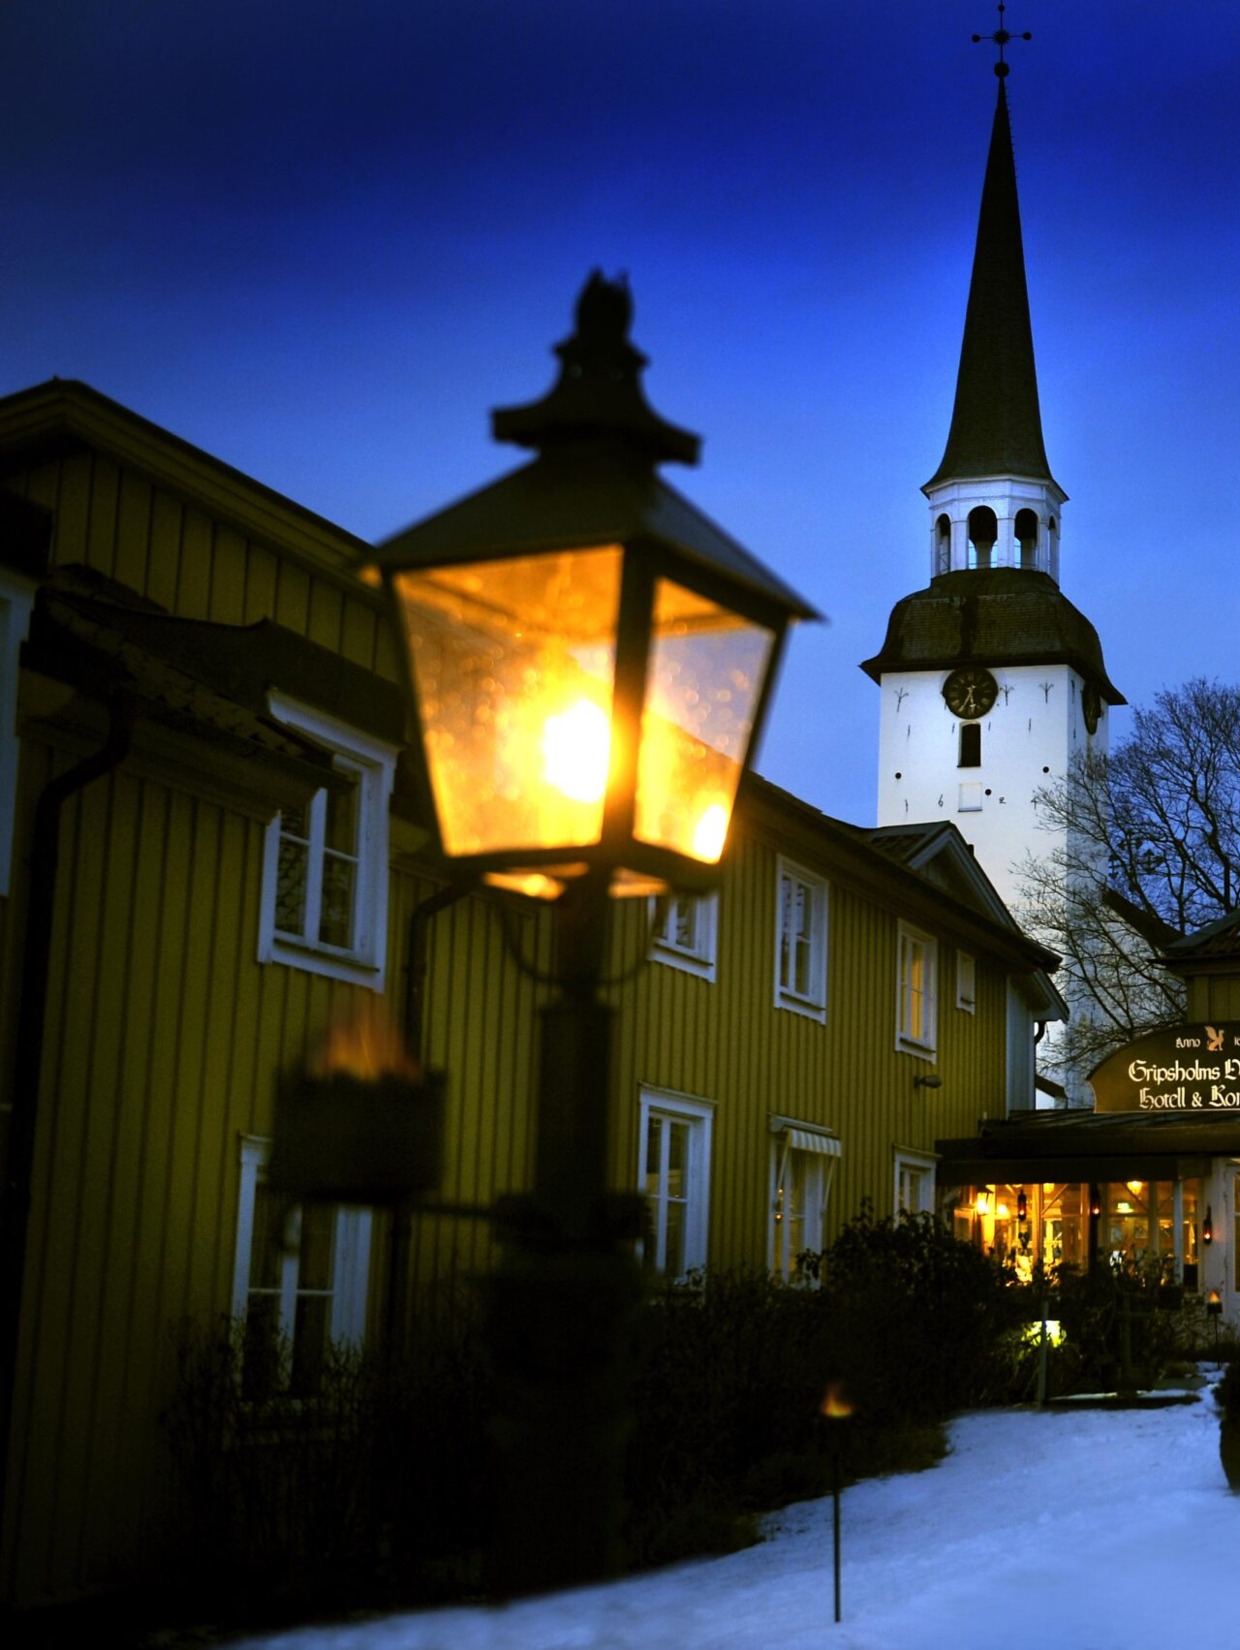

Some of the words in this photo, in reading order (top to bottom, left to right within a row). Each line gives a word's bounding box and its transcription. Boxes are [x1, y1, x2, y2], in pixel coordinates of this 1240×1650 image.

[1176, 1036, 1201, 1049] Anno
[1128, 1058, 1221, 1086] Gripsholms
[1139, 1086, 1186, 1110] Hotell
[1191, 1091, 1203, 1108] &
